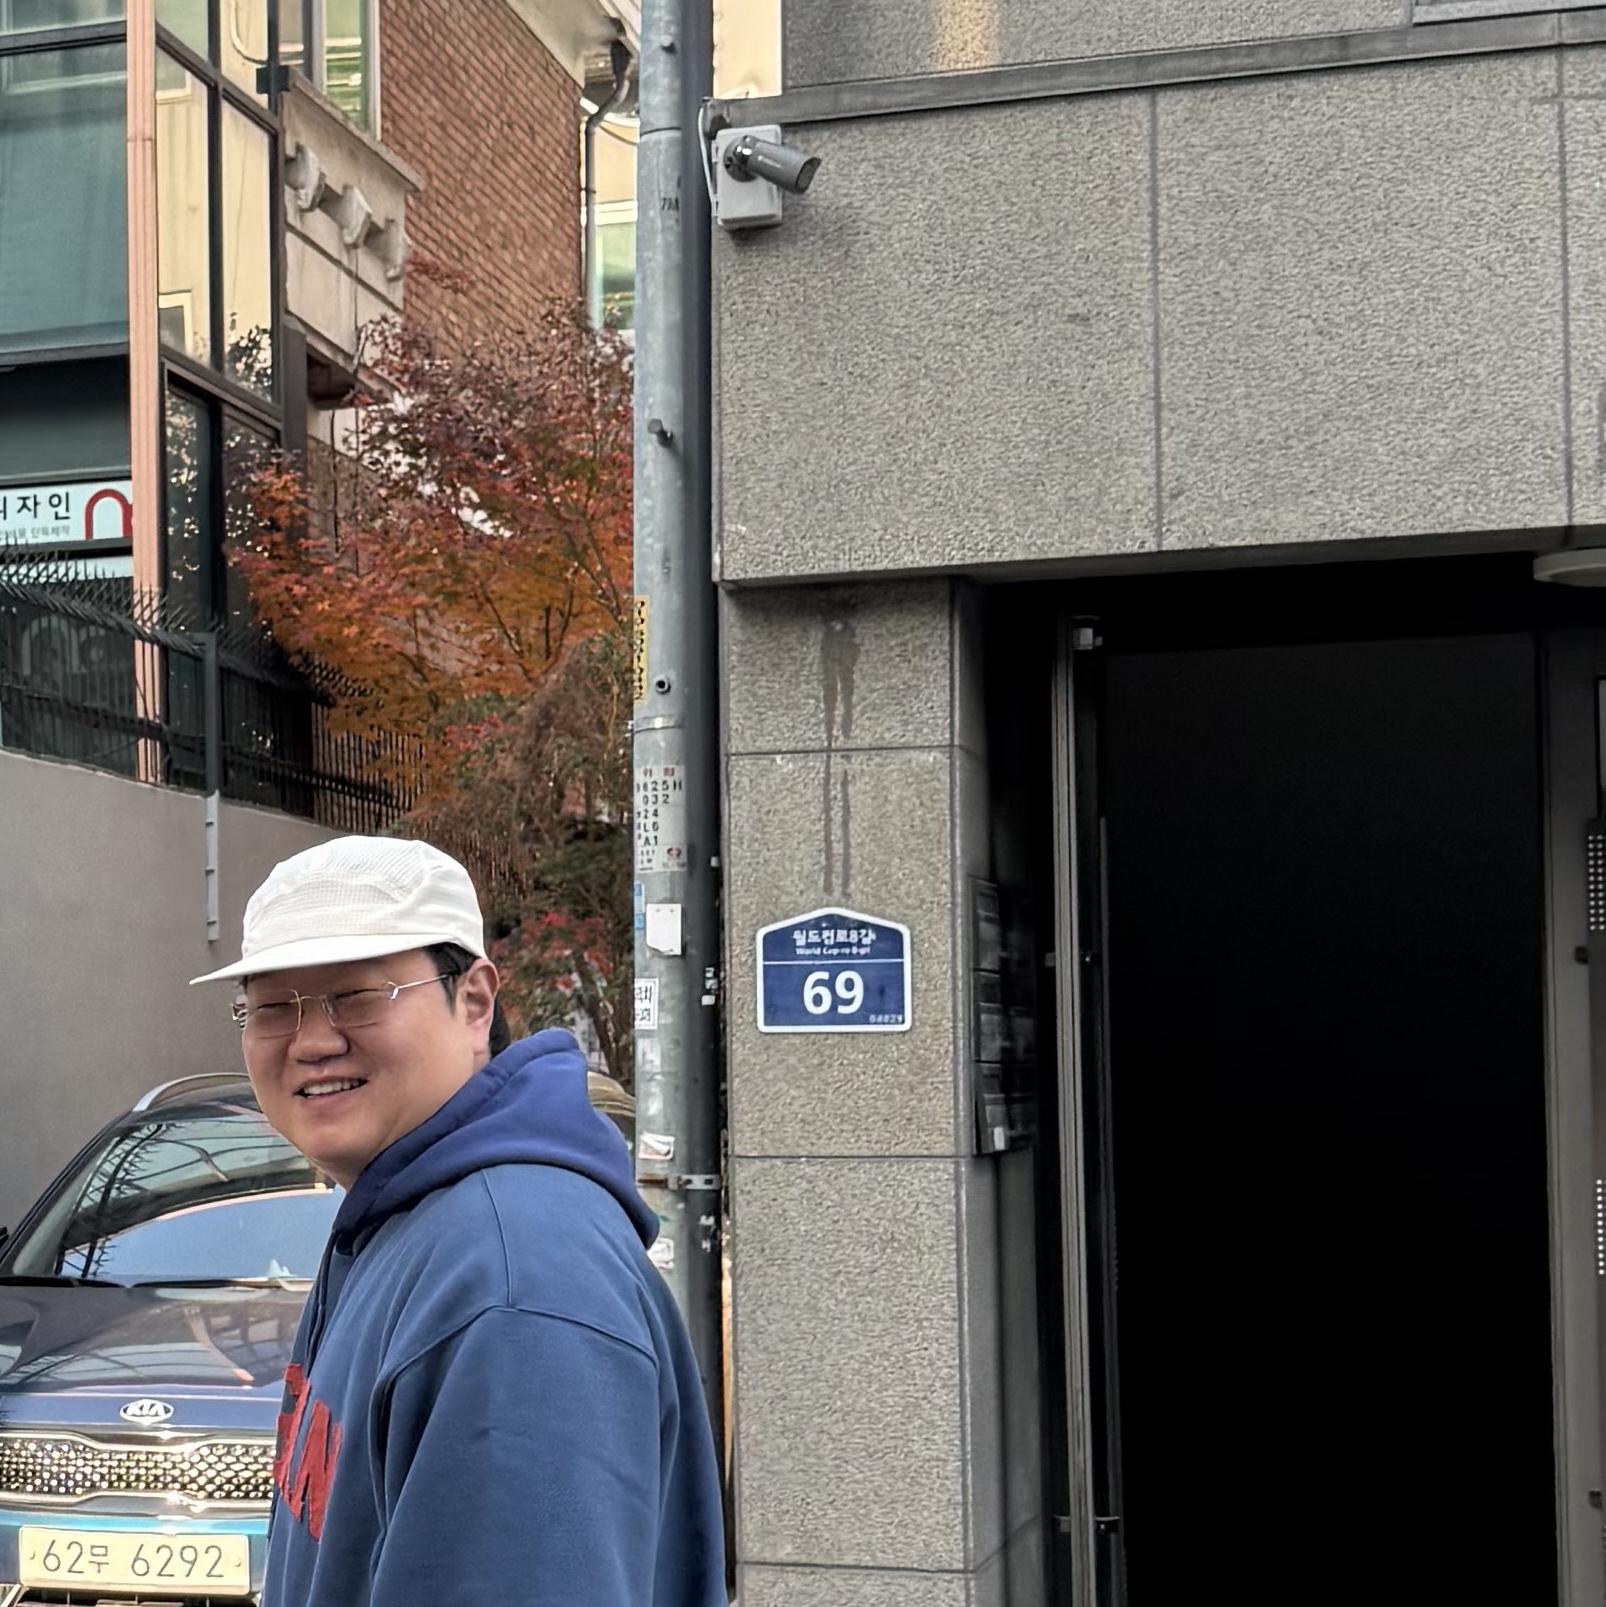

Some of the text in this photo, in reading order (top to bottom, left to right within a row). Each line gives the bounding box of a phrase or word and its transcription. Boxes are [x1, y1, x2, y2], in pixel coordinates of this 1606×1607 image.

[803, 970, 864, 1014] 69
[127, 1402, 166, 1416] KIA
[43, 1539, 225, 1579] 62무 6292
